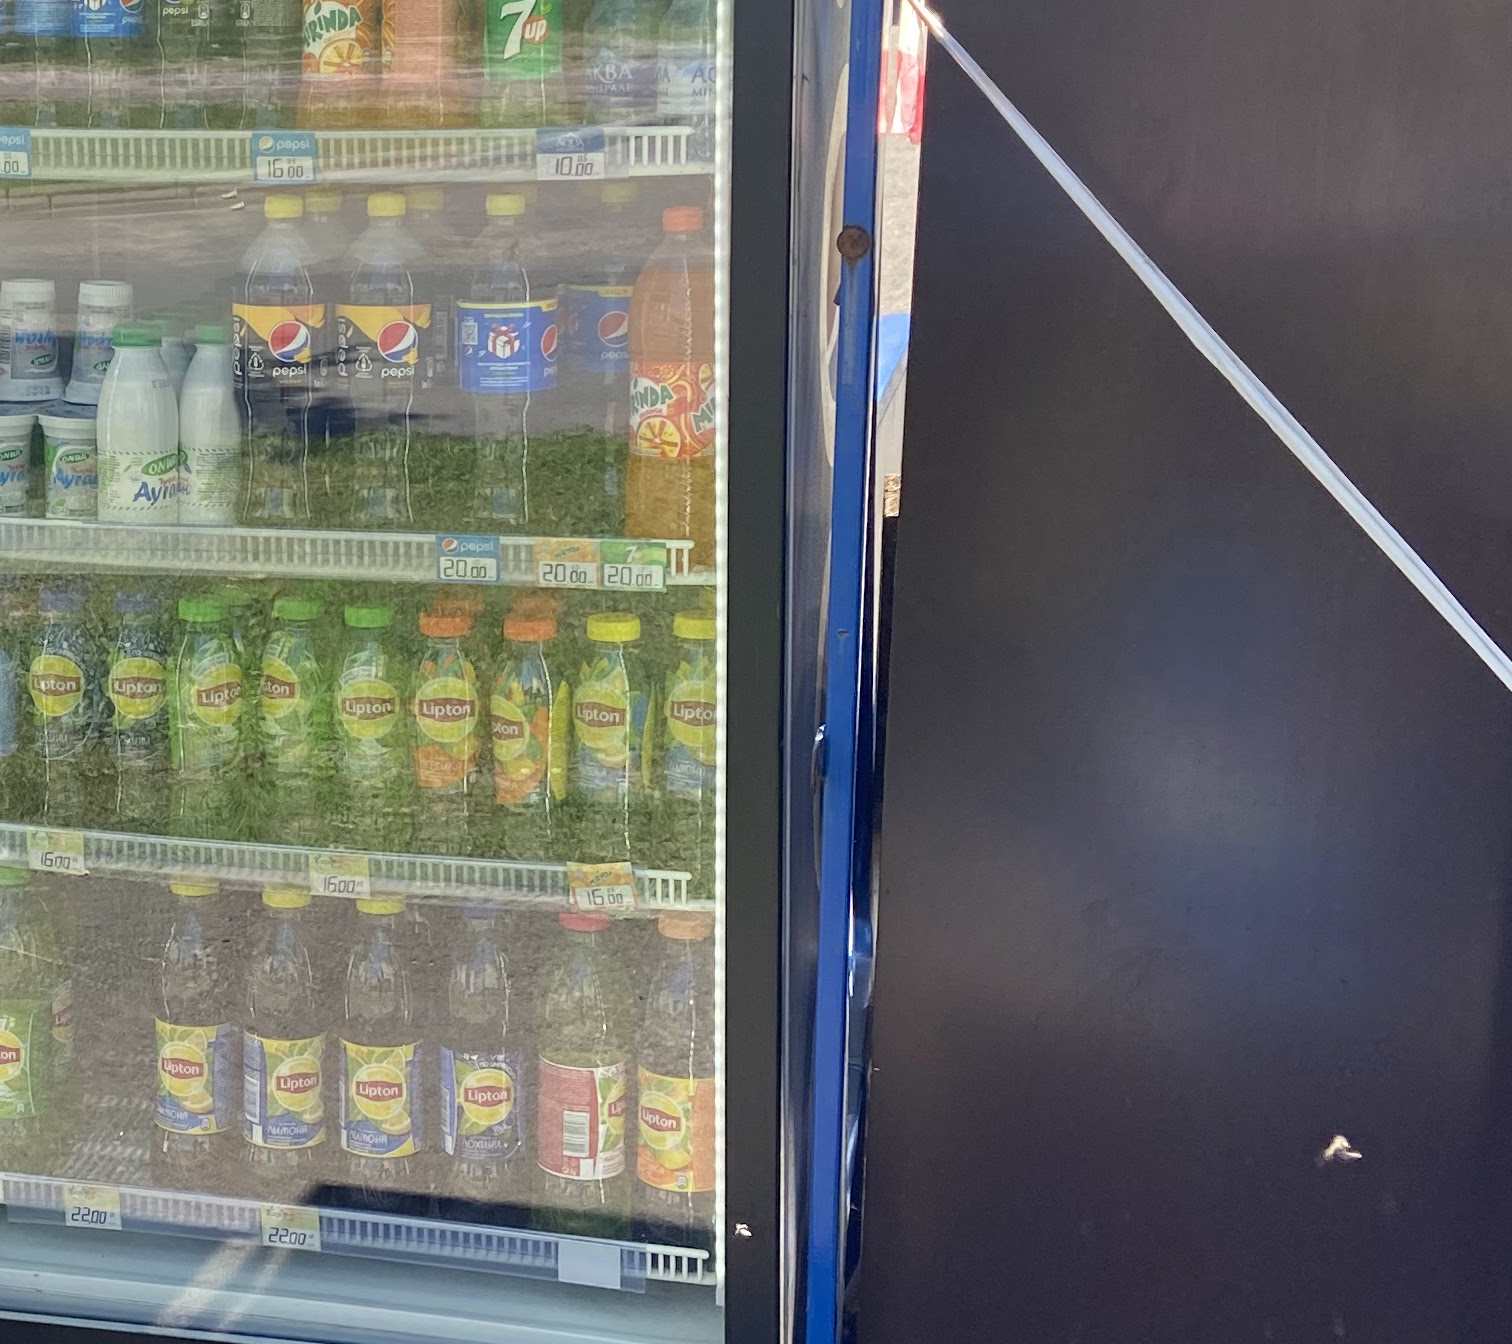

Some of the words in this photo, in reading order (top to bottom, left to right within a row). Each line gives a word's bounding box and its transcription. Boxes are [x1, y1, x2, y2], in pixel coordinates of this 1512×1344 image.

[272, 363, 307, 378] pepsi
[381, 363, 415, 378] pepsi
[460, 542, 493, 553] pepsi
[345, 700, 391, 717] Lipton
[423, 702, 471, 719] Lipton
[577, 705, 620, 723] Lipton
[163, 1059, 200, 1075] Lipton
[280, 1076, 317, 1091] Lipton
[359, 1084, 399, 1097] Lipton
[467, 1089, 508, 1104] Lipton
[642, 1111, 677, 1129] Lipton
